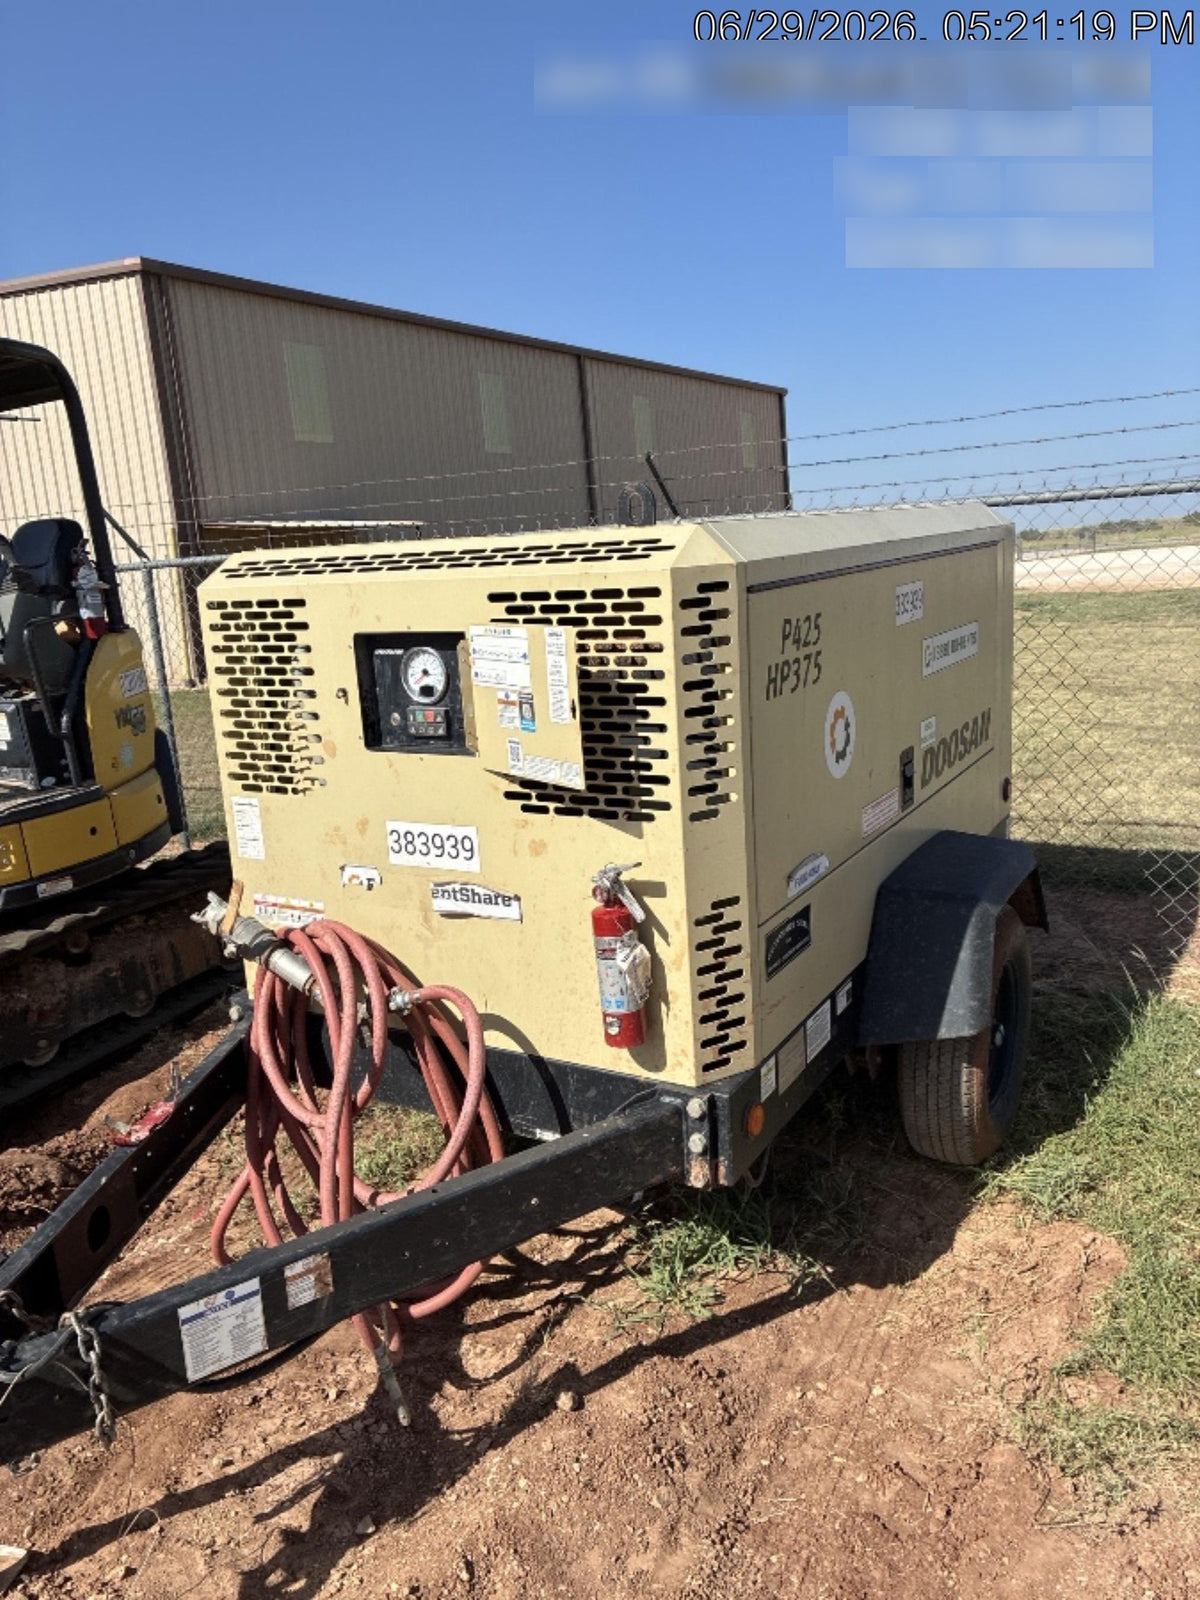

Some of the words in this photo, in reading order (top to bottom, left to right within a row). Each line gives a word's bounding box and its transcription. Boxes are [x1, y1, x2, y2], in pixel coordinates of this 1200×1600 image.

[780, 612, 822, 655] P425
[765, 649, 822, 701] HP375
[920, 707, 991, 789] DOOSAN
[388, 829, 475, 862] 383939
